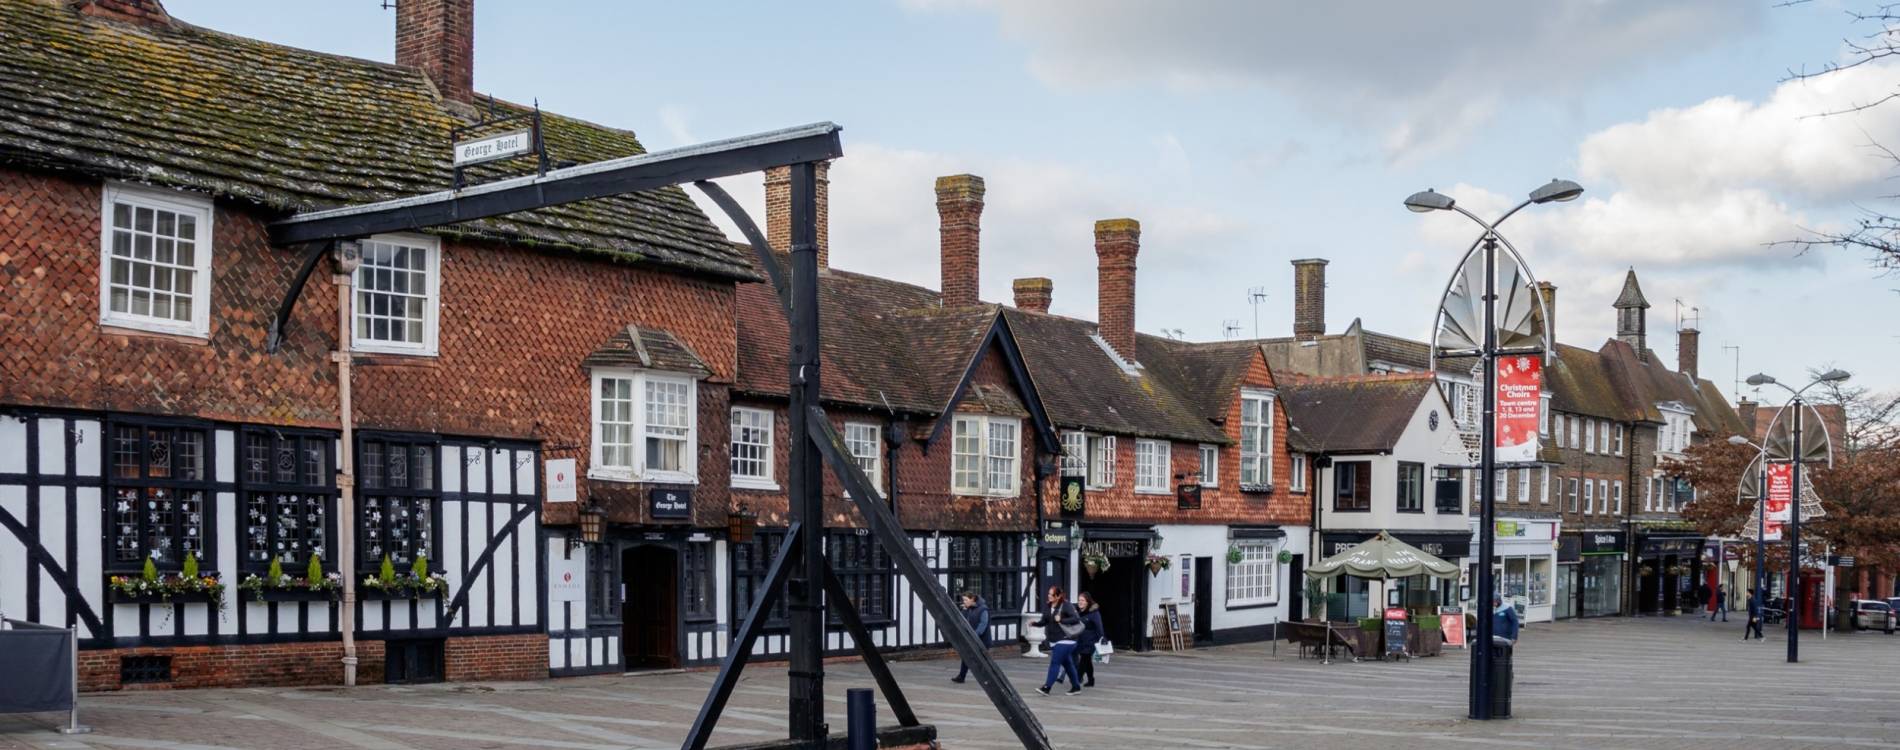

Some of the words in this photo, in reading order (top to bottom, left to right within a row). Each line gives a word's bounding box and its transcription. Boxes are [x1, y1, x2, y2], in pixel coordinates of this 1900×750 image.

[464, 144, 492, 158] George
[496, 136, 518, 151] Hotel
[1500, 384, 1537, 393] Christmas
[666, 493, 676, 501] The
[655, 501, 673, 510] George
[673, 501, 687, 510] Hotel
